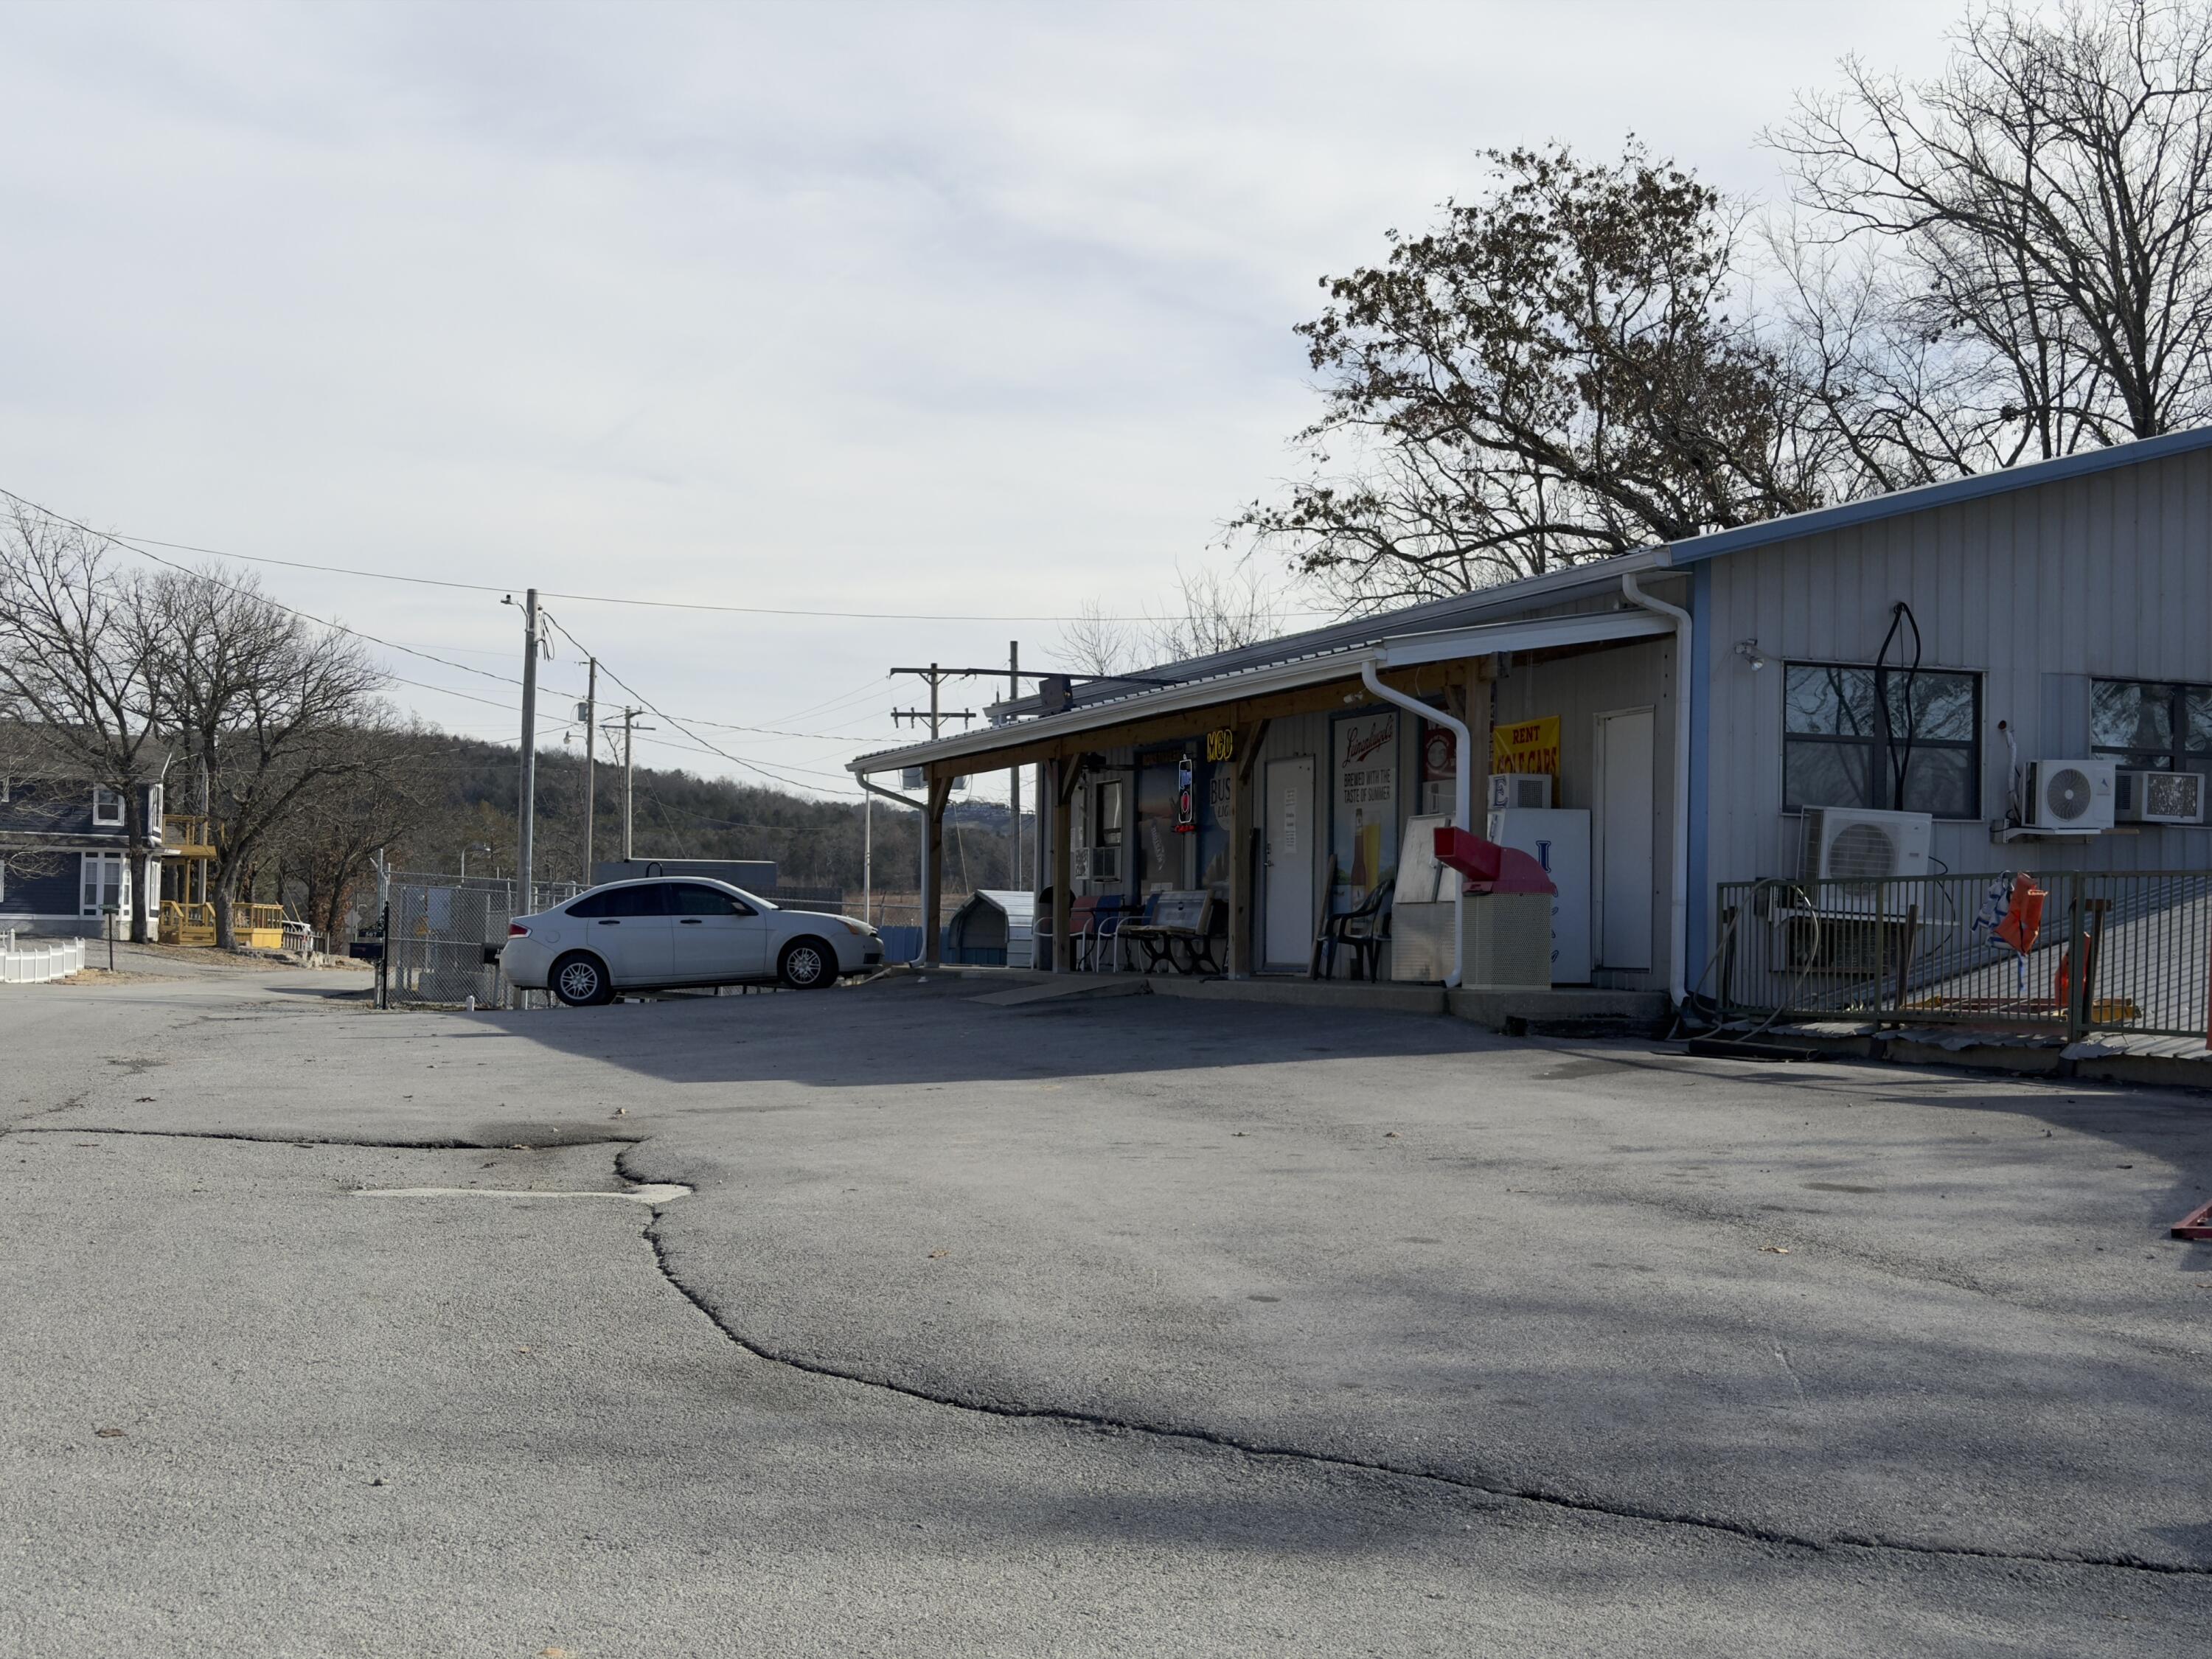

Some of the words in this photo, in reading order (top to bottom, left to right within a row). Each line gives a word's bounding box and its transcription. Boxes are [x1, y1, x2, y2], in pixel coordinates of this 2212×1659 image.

[1512, 726, 1540, 744] RENT
[1207, 729, 1232, 762] MGD
[1497, 751, 1524, 773] GOLF
[1528, 746, 1557, 774] CARS
[1344, 771, 1365, 787] BREWED
[1366, 770, 1380, 785] WITH
[1380, 768, 1391, 784] THE
[1211, 778, 1231, 805] BUS
[1344, 788, 1360, 804] TASTE
[1360, 787, 1368, 802] OF
[1368, 786, 1390, 801] SUMMER
[1217, 804, 1229, 818] LIG
